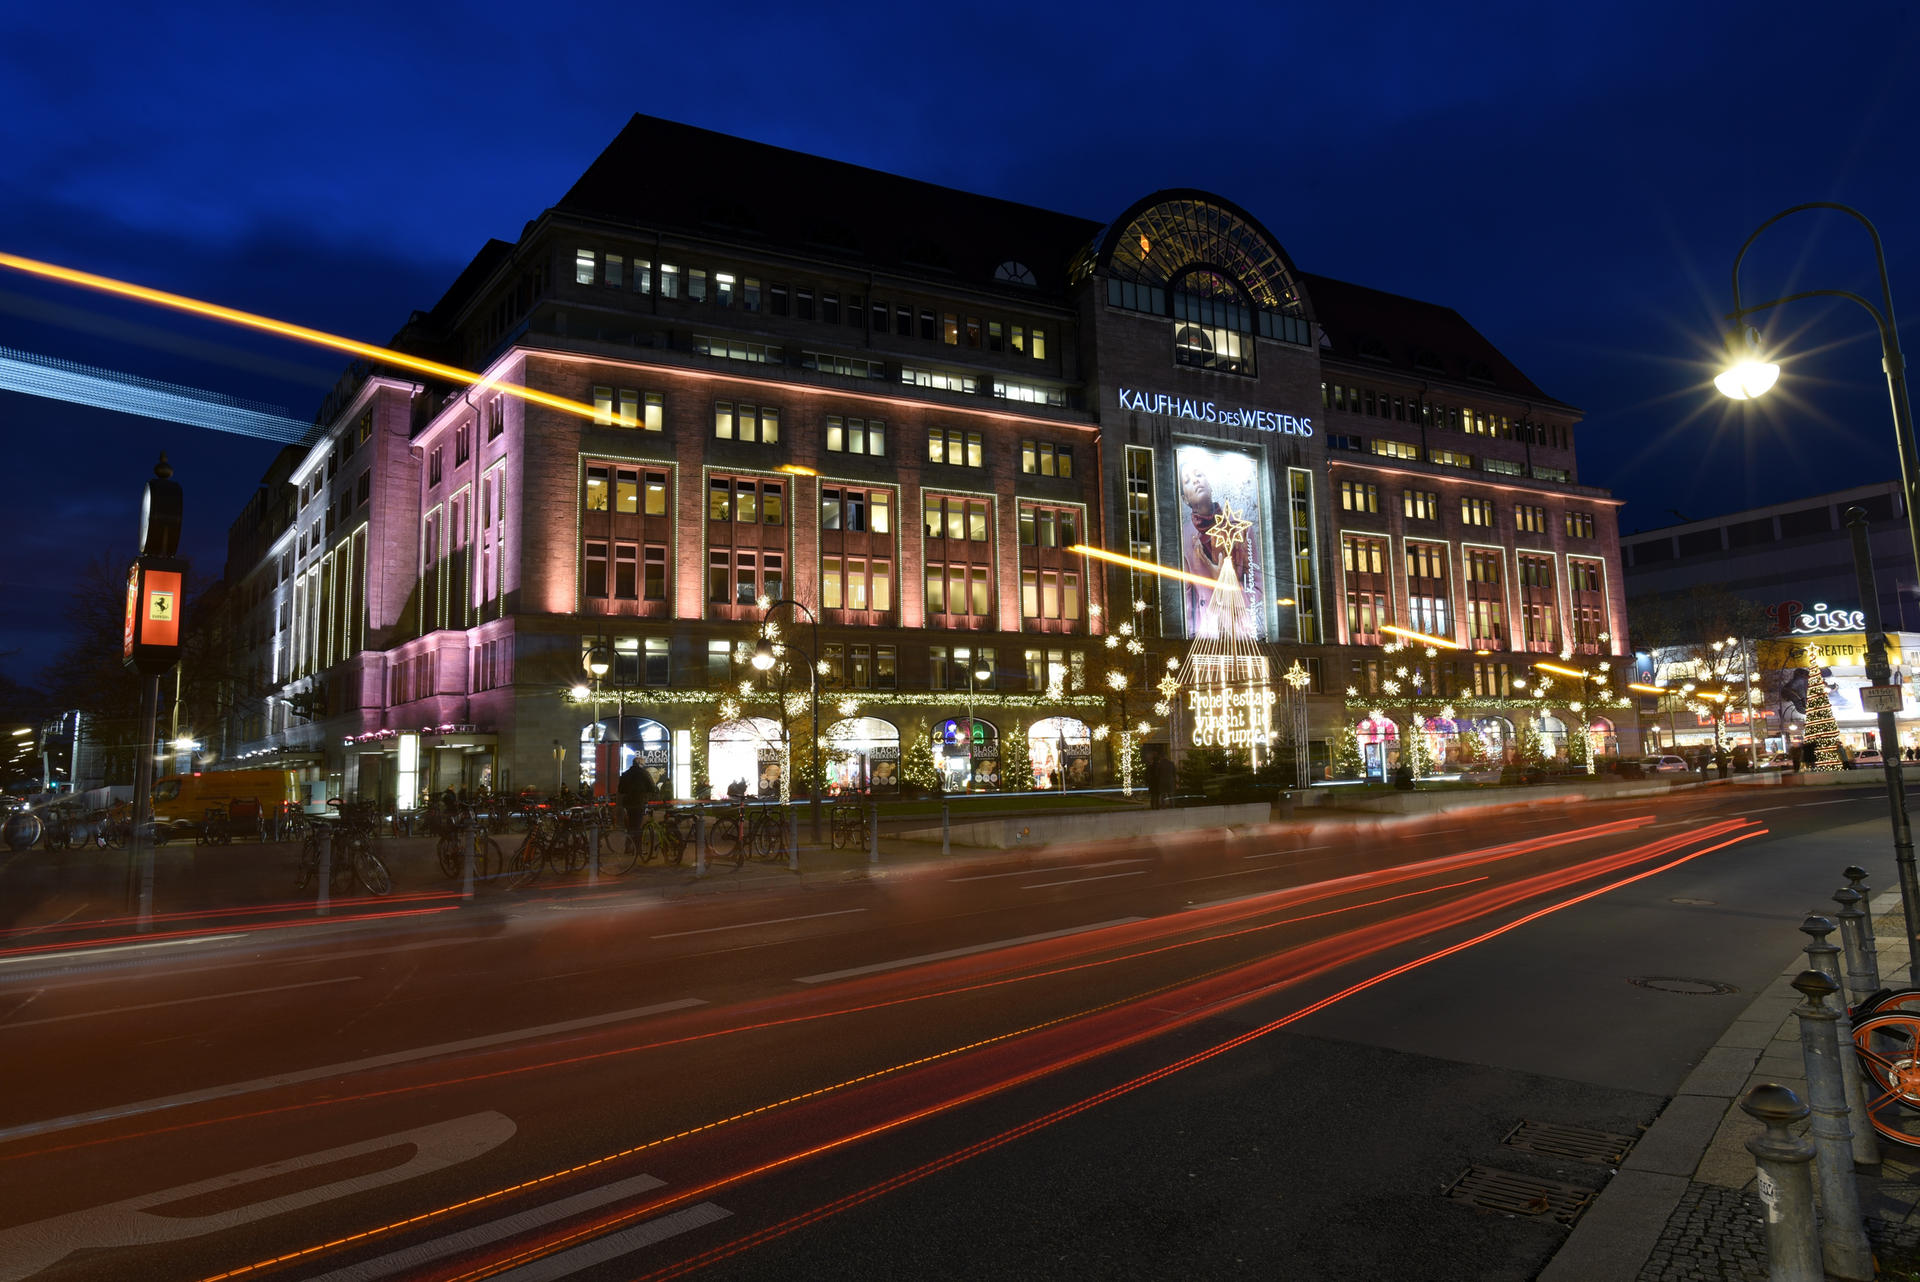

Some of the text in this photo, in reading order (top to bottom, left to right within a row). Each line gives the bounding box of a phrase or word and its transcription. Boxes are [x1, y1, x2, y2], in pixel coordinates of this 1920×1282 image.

[1119, 388, 1314, 437] KAUFHAUS DES WESTENS
[1766, 600, 1866, 633] Leise
[1818, 645, 1854, 656] REATED
[635, 750, 668, 758] BLACK
[870, 746, 897, 754] BLACK
